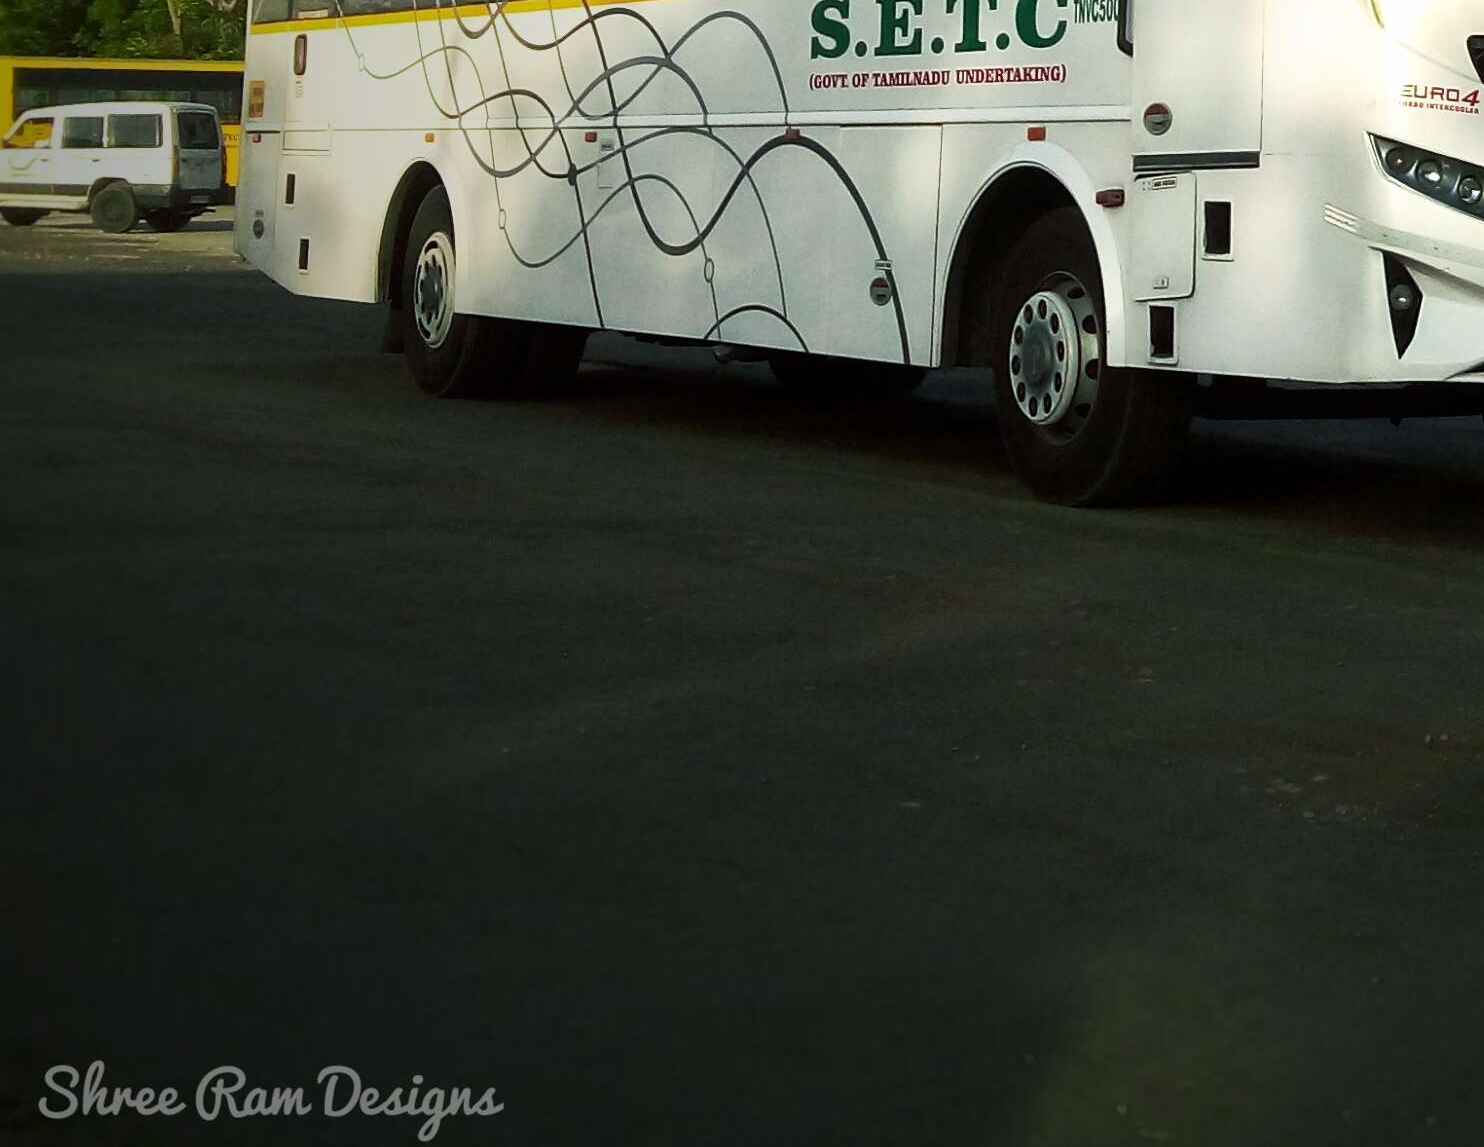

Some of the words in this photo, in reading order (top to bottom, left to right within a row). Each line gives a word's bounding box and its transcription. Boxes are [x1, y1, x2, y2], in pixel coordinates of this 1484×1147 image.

[852, 73, 869, 88] OF
[872, 70, 951, 87] TAMILNADU
[956, 64, 1067, 84] UNDERTAKING)
